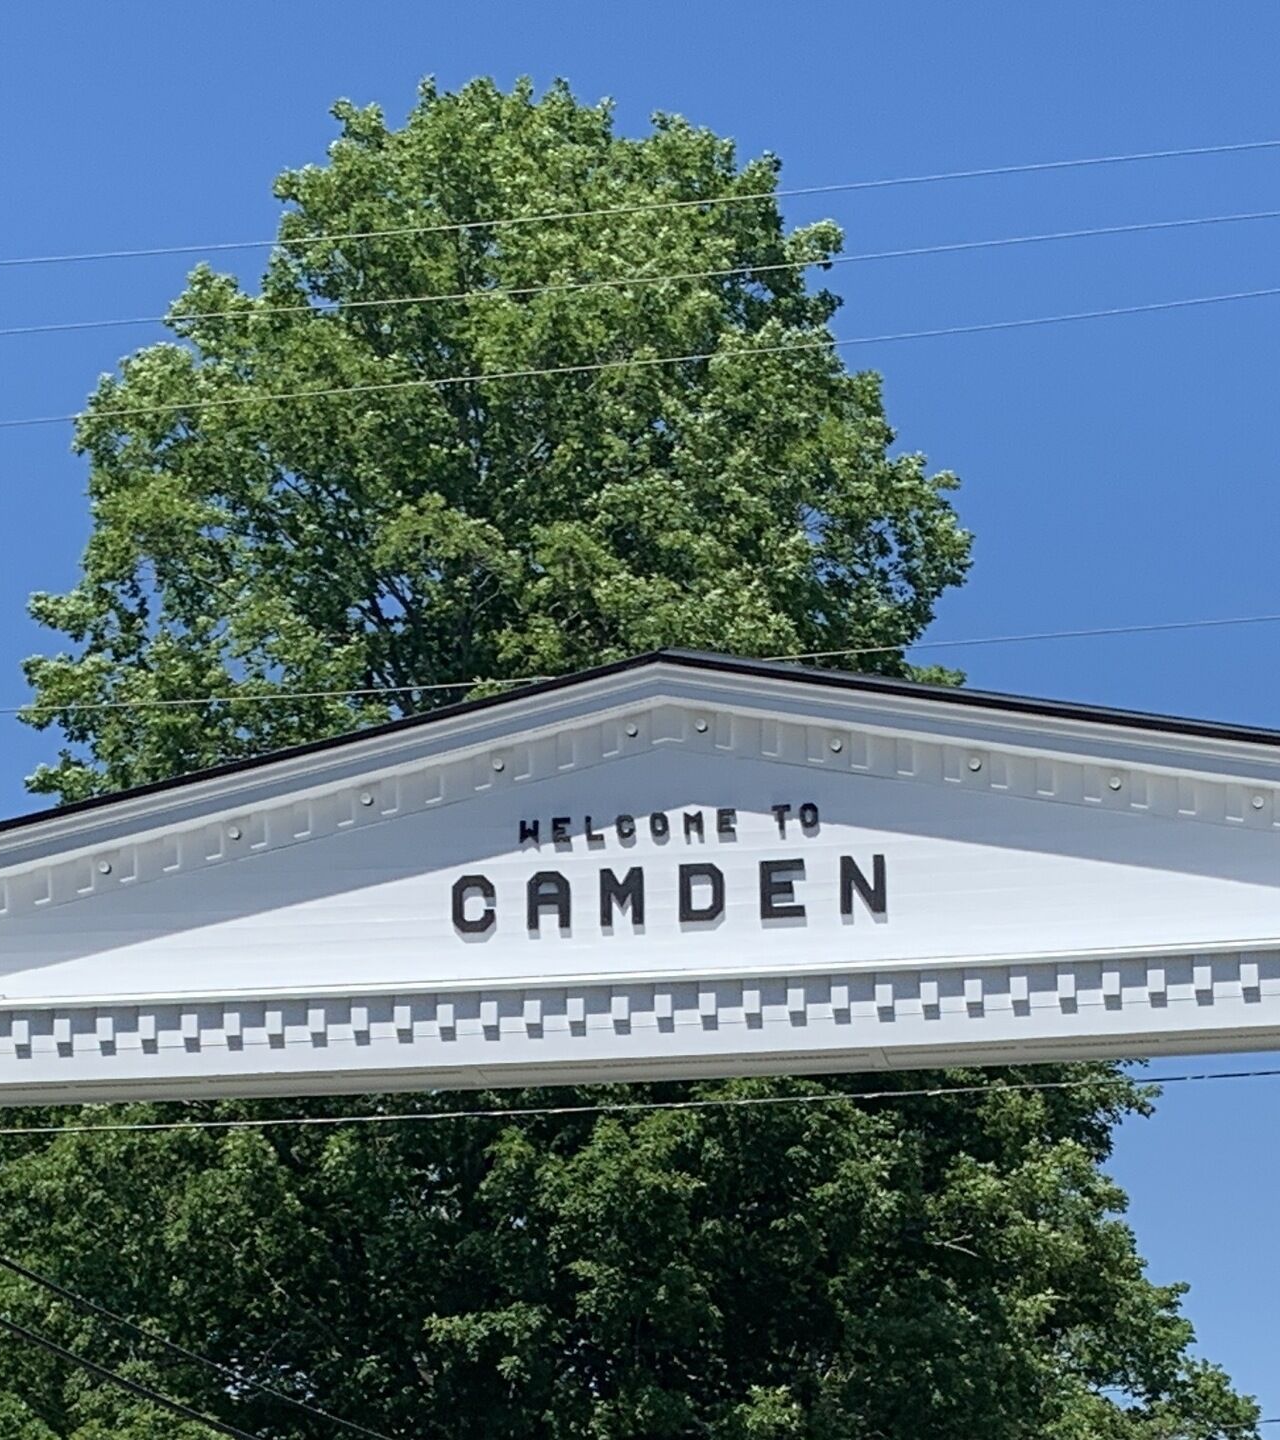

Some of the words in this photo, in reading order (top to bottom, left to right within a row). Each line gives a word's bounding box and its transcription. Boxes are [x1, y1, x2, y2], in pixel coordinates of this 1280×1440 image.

[519, 807, 737, 845] WELCOME
[771, 802, 821, 832] TO
[451, 853, 888, 935] CAMDEN
